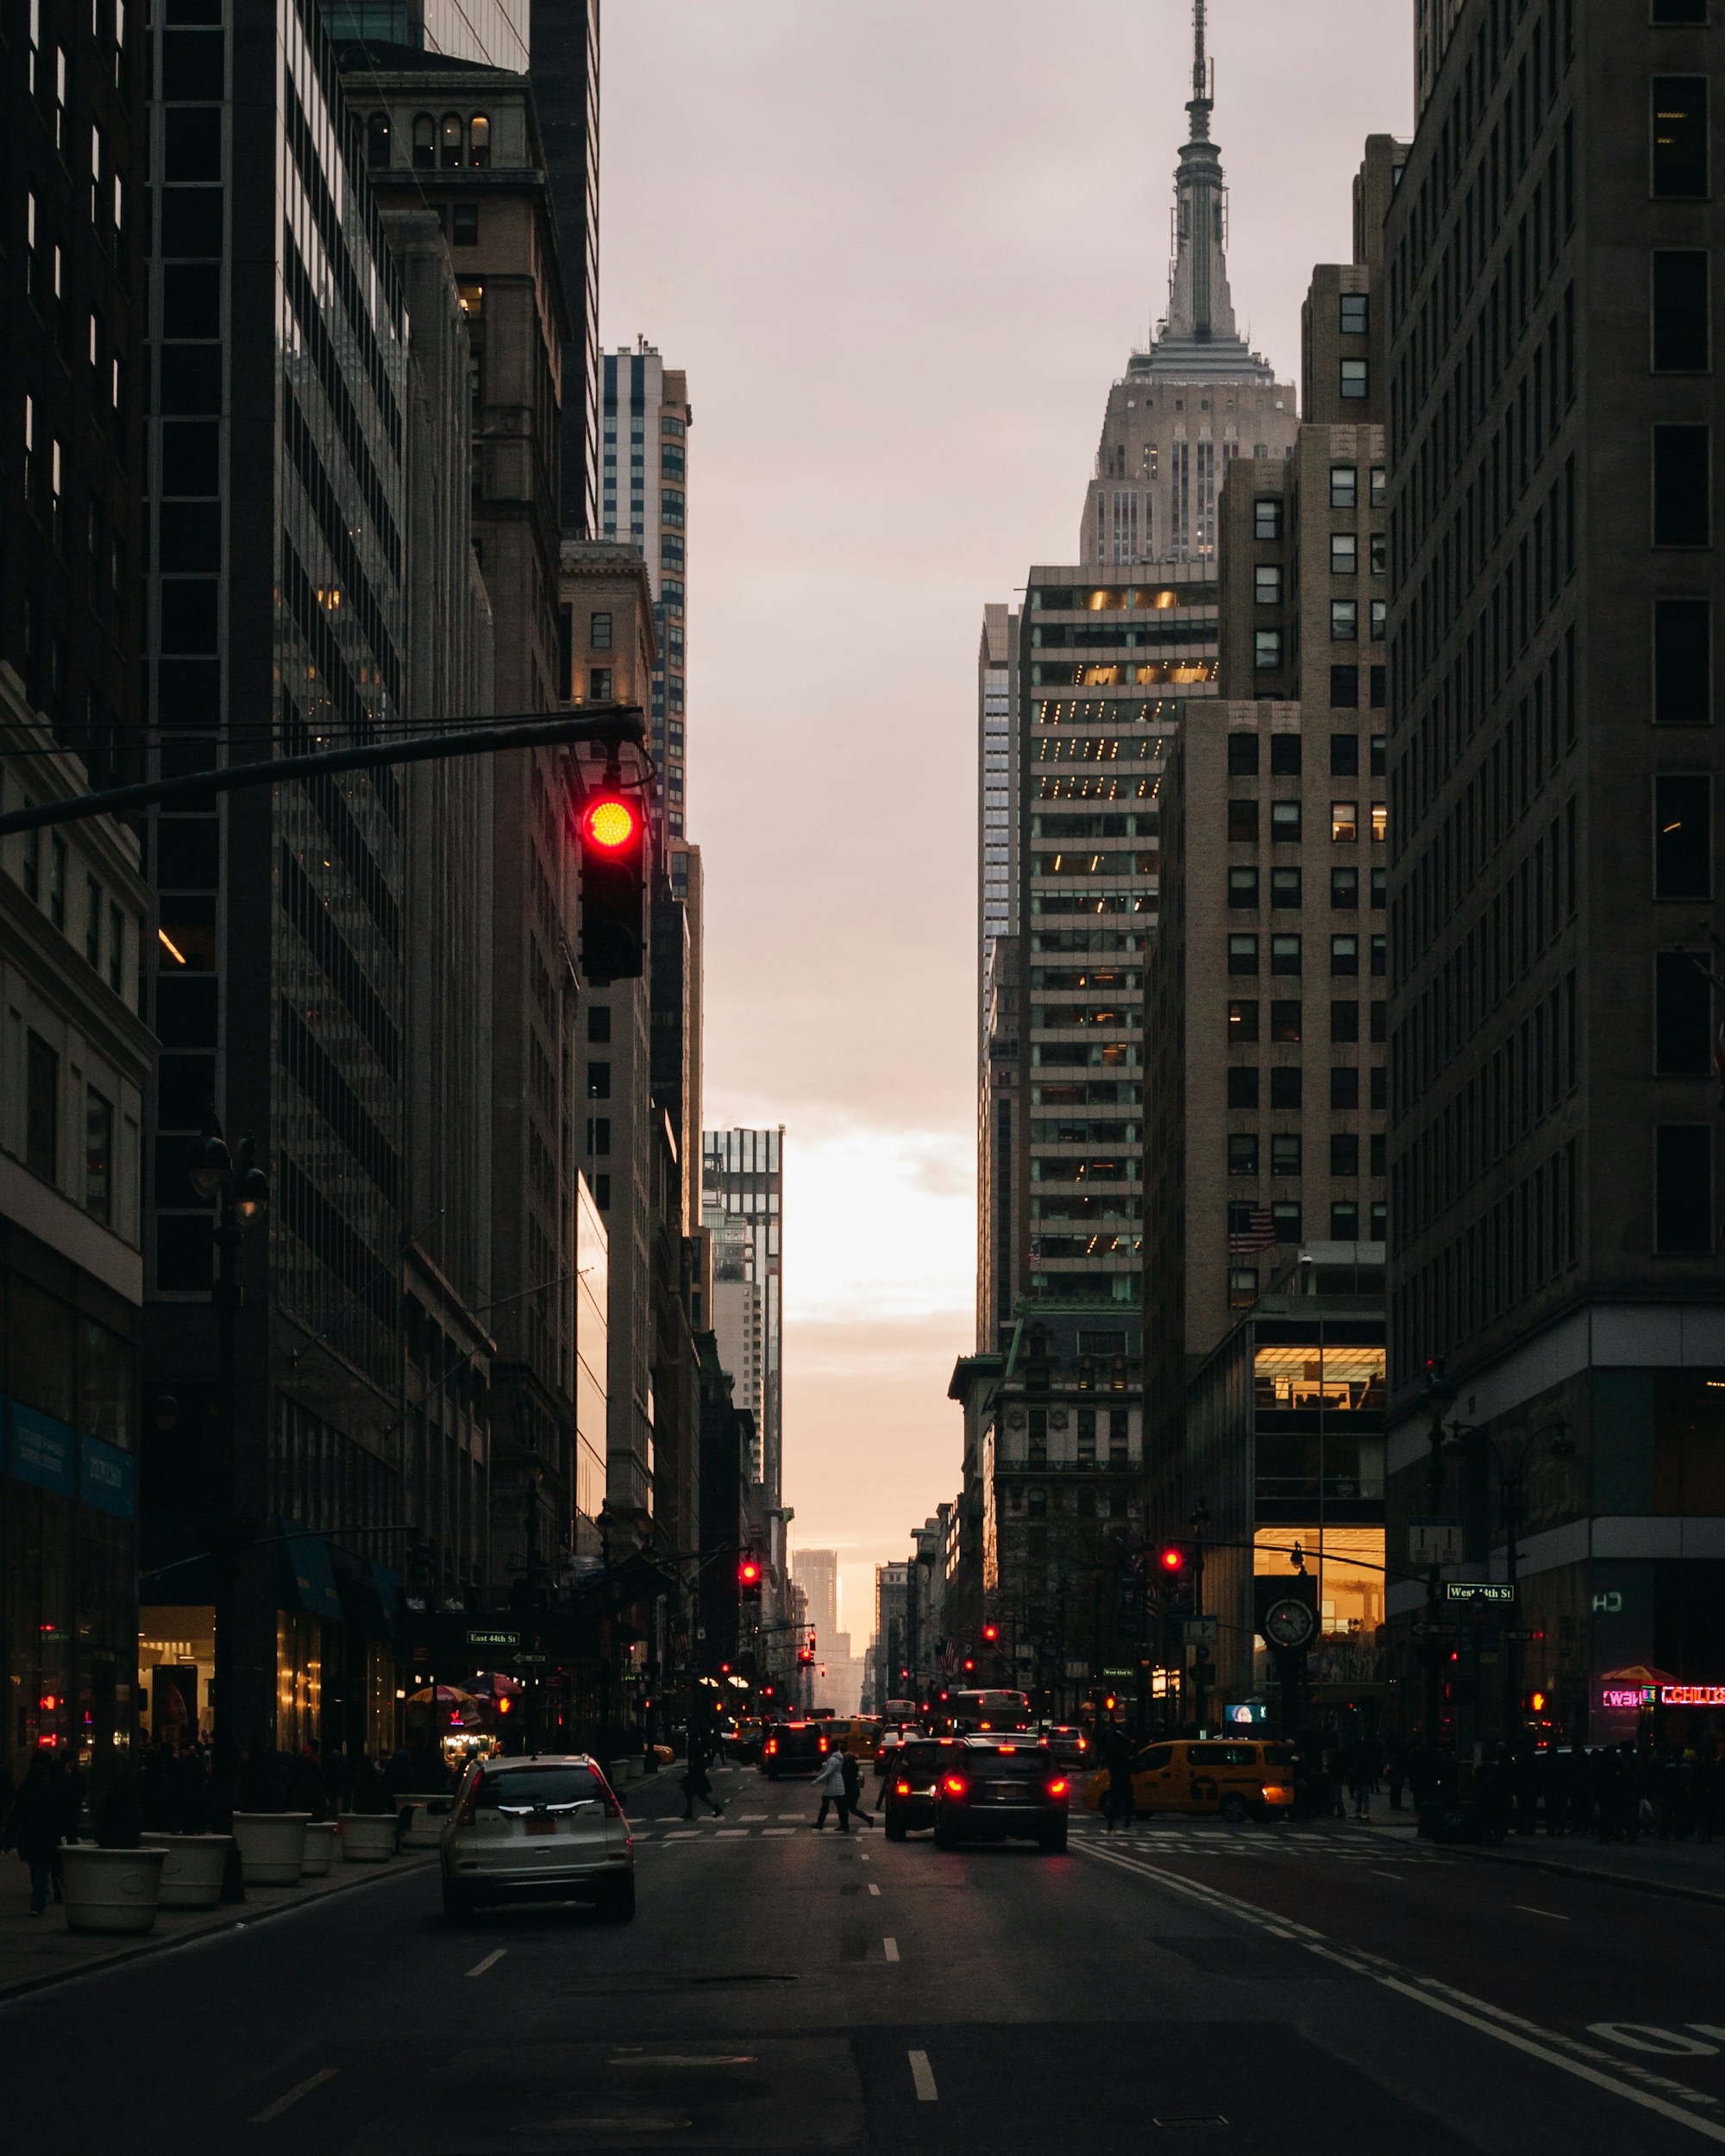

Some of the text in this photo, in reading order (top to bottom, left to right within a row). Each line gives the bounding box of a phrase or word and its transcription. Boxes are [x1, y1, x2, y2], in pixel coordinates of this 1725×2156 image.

[1501, 1589, 1511, 1599] St
[470, 1633, 487, 1642] East
[507, 1635, 517, 1644] St
